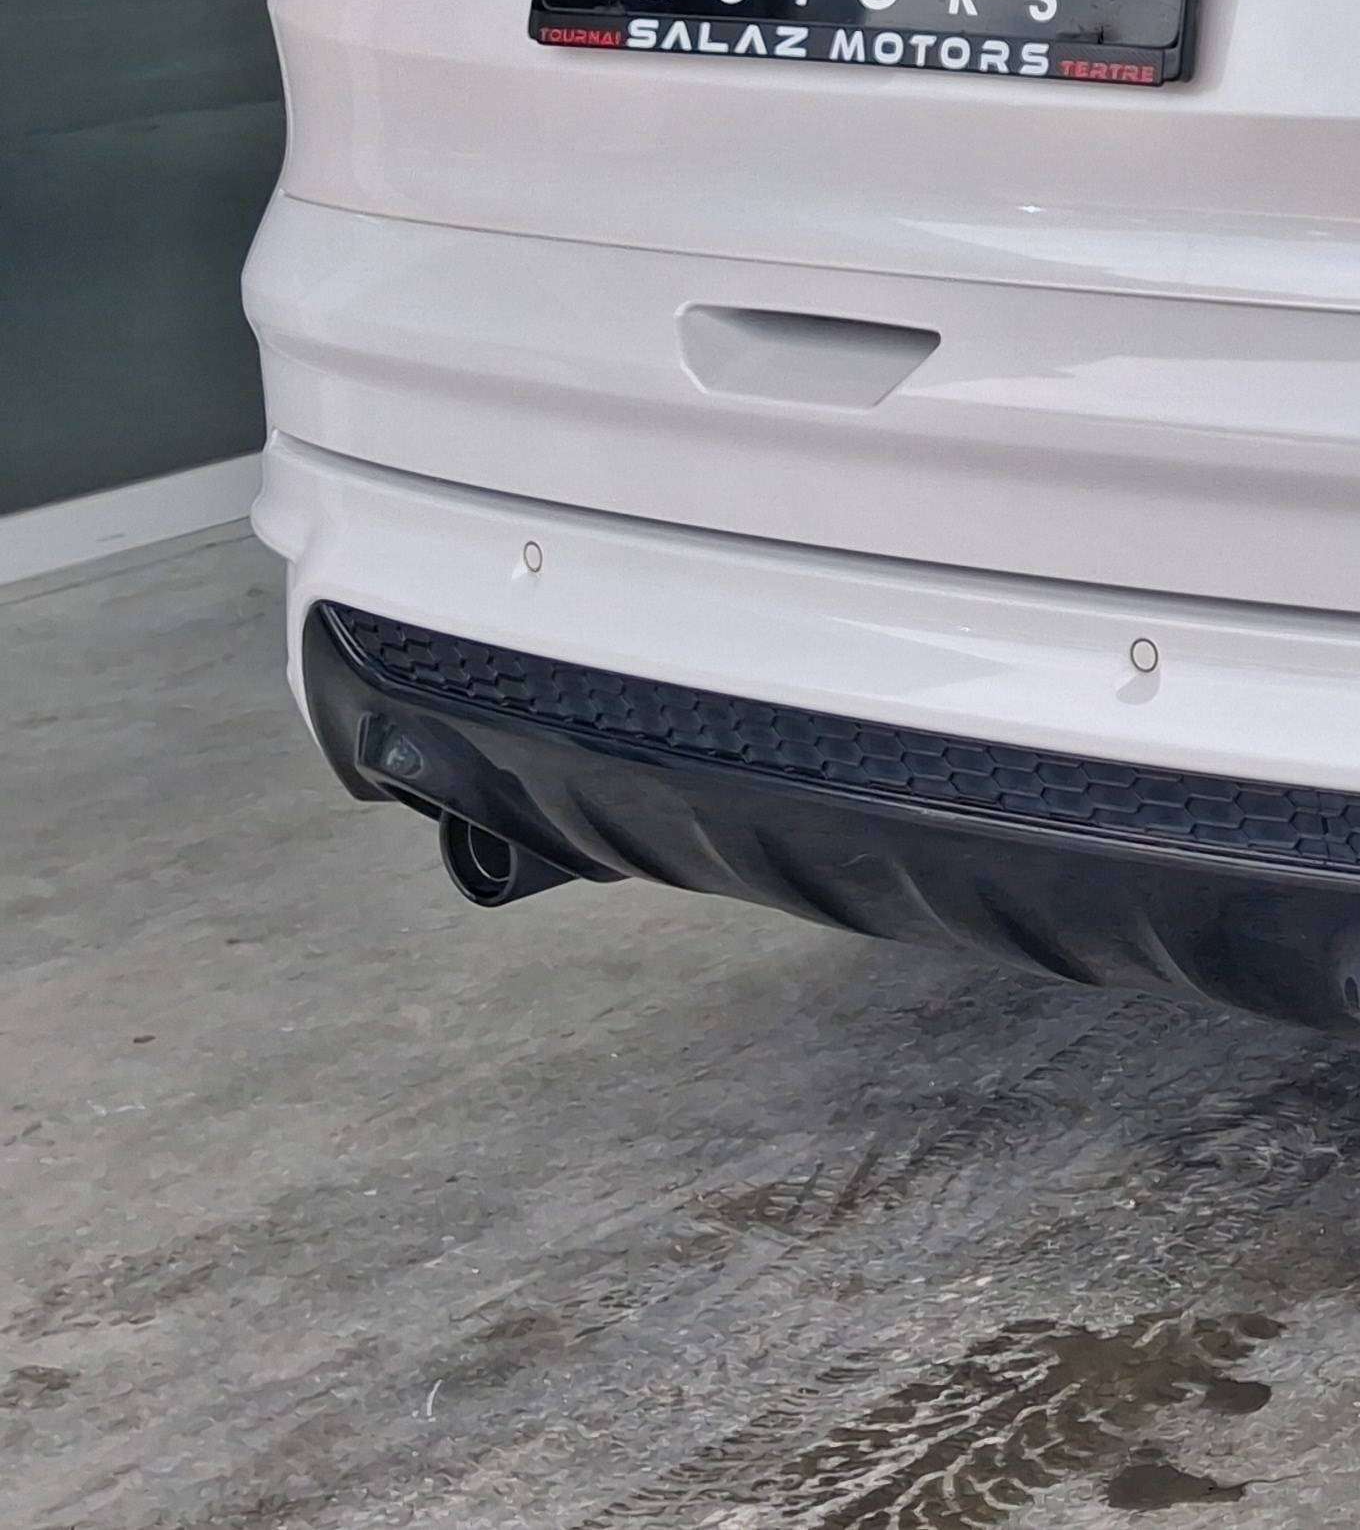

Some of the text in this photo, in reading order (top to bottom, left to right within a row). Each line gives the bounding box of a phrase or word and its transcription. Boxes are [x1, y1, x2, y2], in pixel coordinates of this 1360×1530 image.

[539, 18, 1155, 83] TOURNAI SALAZ MOTORS TERTRE
